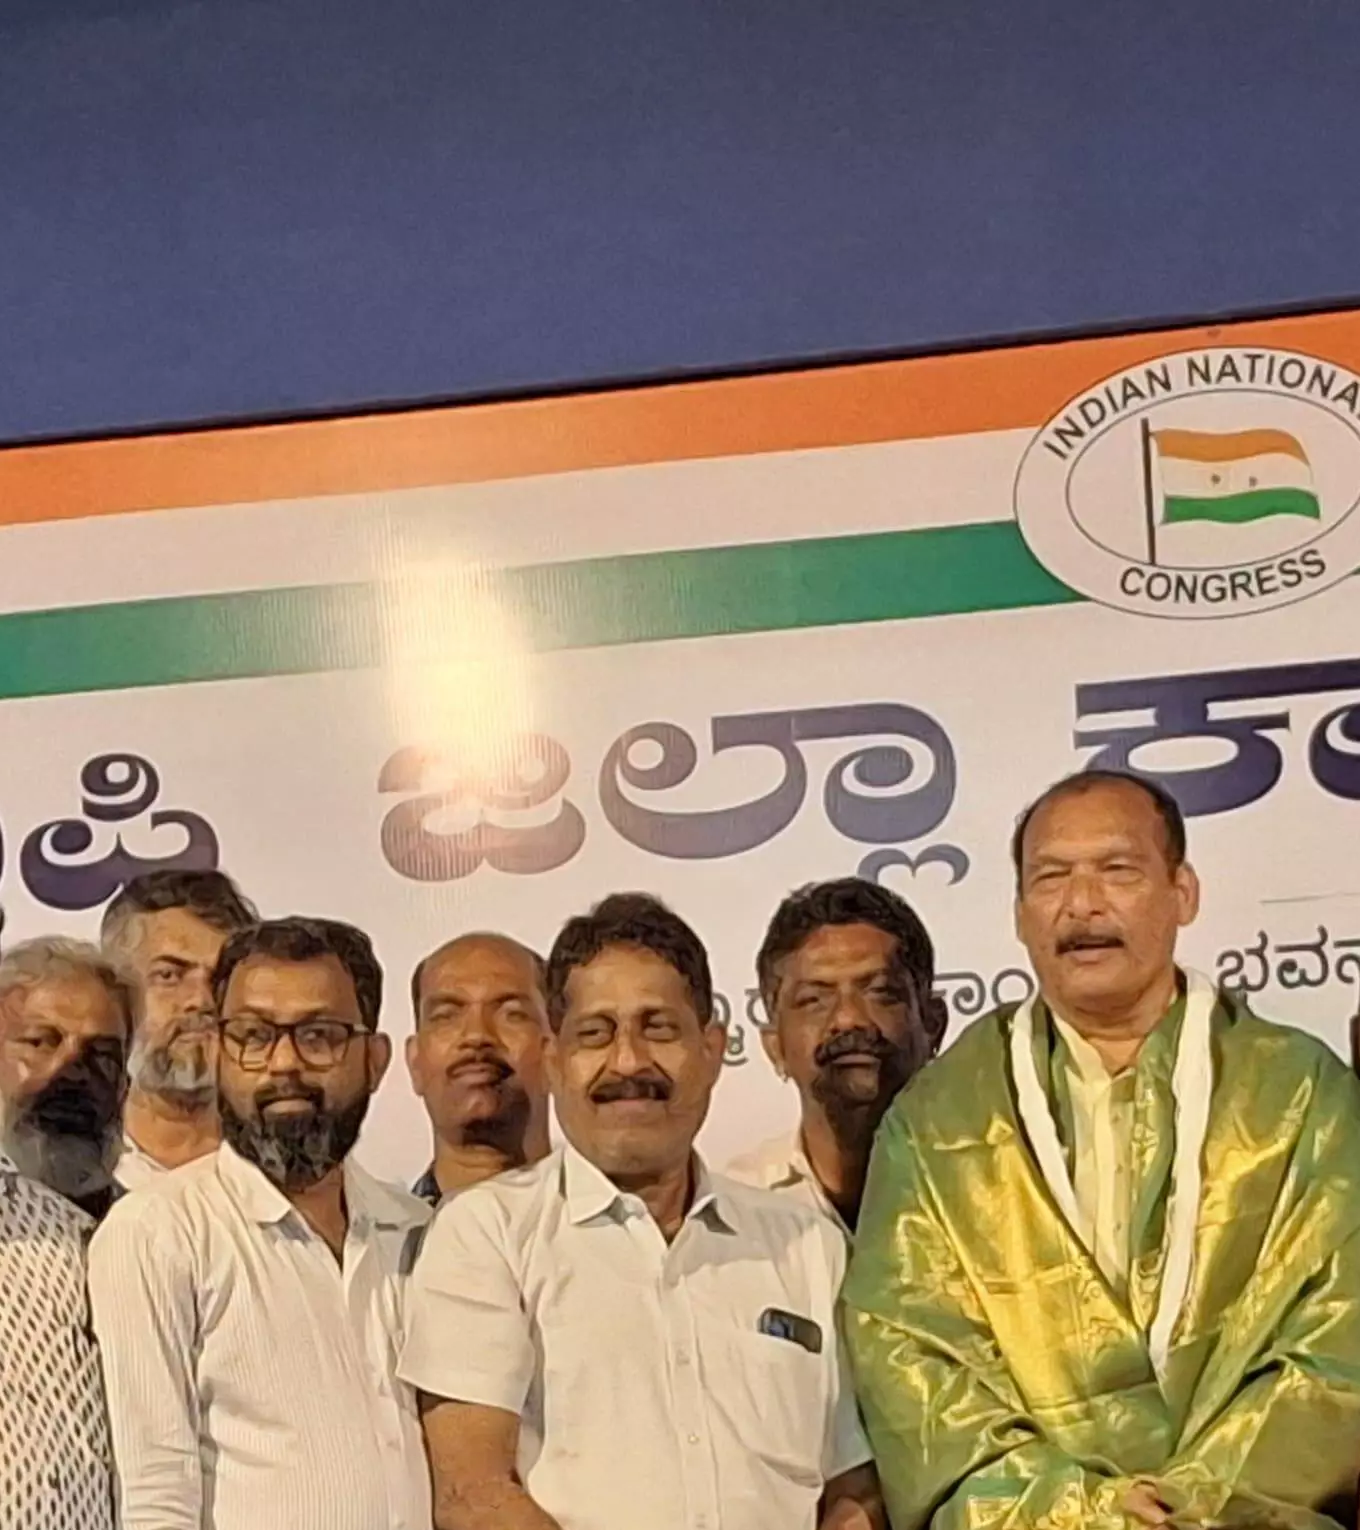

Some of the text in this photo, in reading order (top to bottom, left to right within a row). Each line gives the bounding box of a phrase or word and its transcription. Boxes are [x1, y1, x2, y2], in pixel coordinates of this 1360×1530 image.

[1043, 363, 1172, 460] INDIAN
[1119, 549, 1327, 602] CONGRESS
[377, 702, 970, 886] ಜಿಲ್ಲಾ
